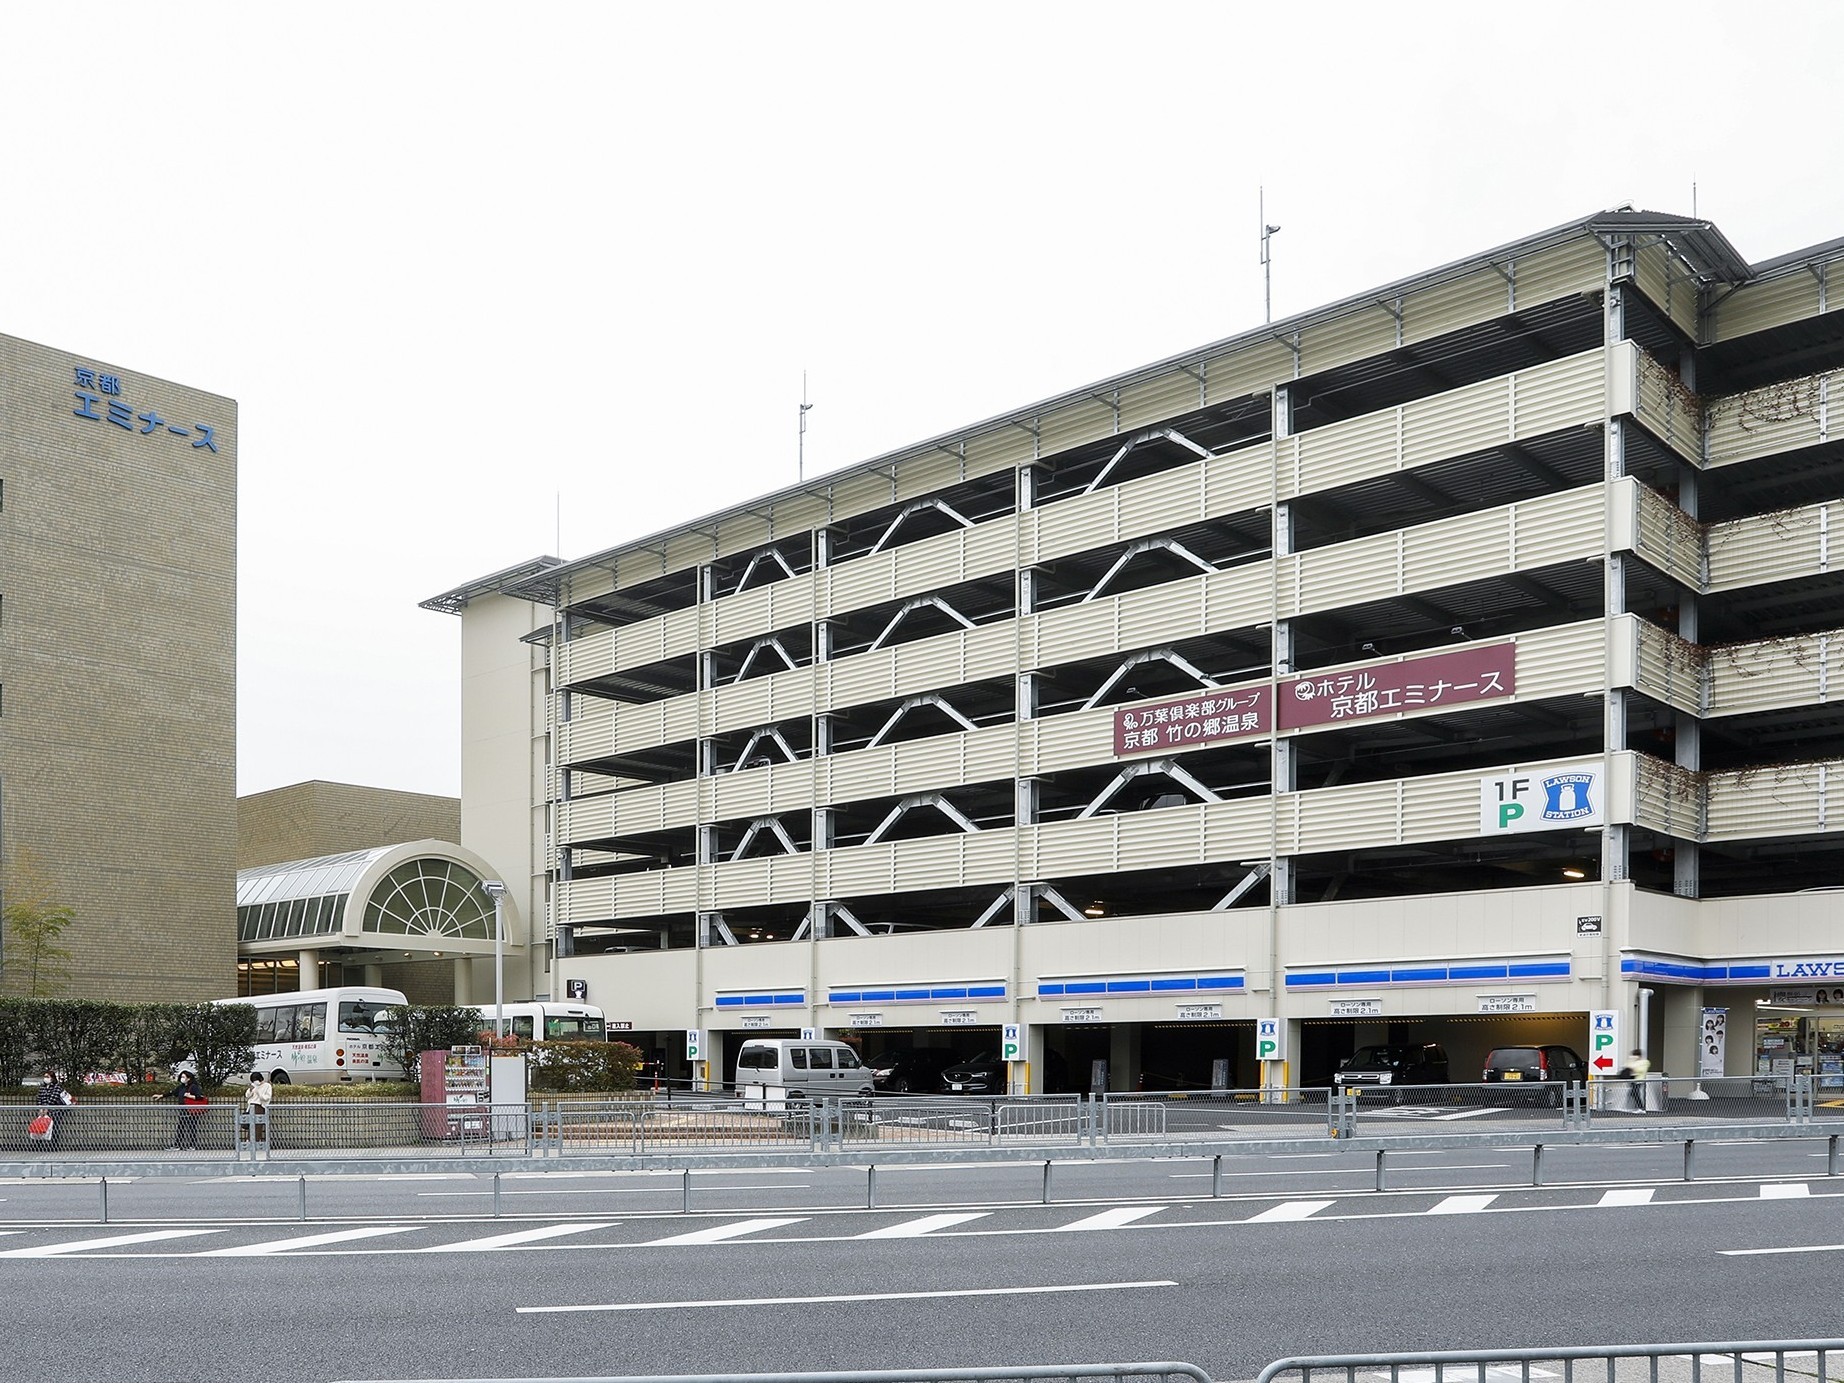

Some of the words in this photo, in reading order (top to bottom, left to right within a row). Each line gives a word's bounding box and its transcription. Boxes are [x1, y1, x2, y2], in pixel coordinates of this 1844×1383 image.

[74, 367, 121, 395] 京都
[73, 391, 218, 453] エミナース
[1317, 673, 1376, 697] ホテル
[1330, 671, 1504, 718] 京都エミナース
[1140, 692, 1261, 727] 万葉倶楽部グループ
[1123, 729, 1158, 749] 京都
[1166, 711, 1259, 743] 竹の郷温泉
[1495, 778, 1530, 801] 1F
[1545, 775, 1591, 788] LAWSON
[1499, 803, 1525, 828] P
[1545, 806, 1590, 819] STATION
[574, 982, 583, 990] P
[688, 1046, 698, 1058] P
[1004, 1043, 1018, 1059] P
[1260, 1040, 1276, 1057] P
[1595, 1034, 1614, 1051] P
